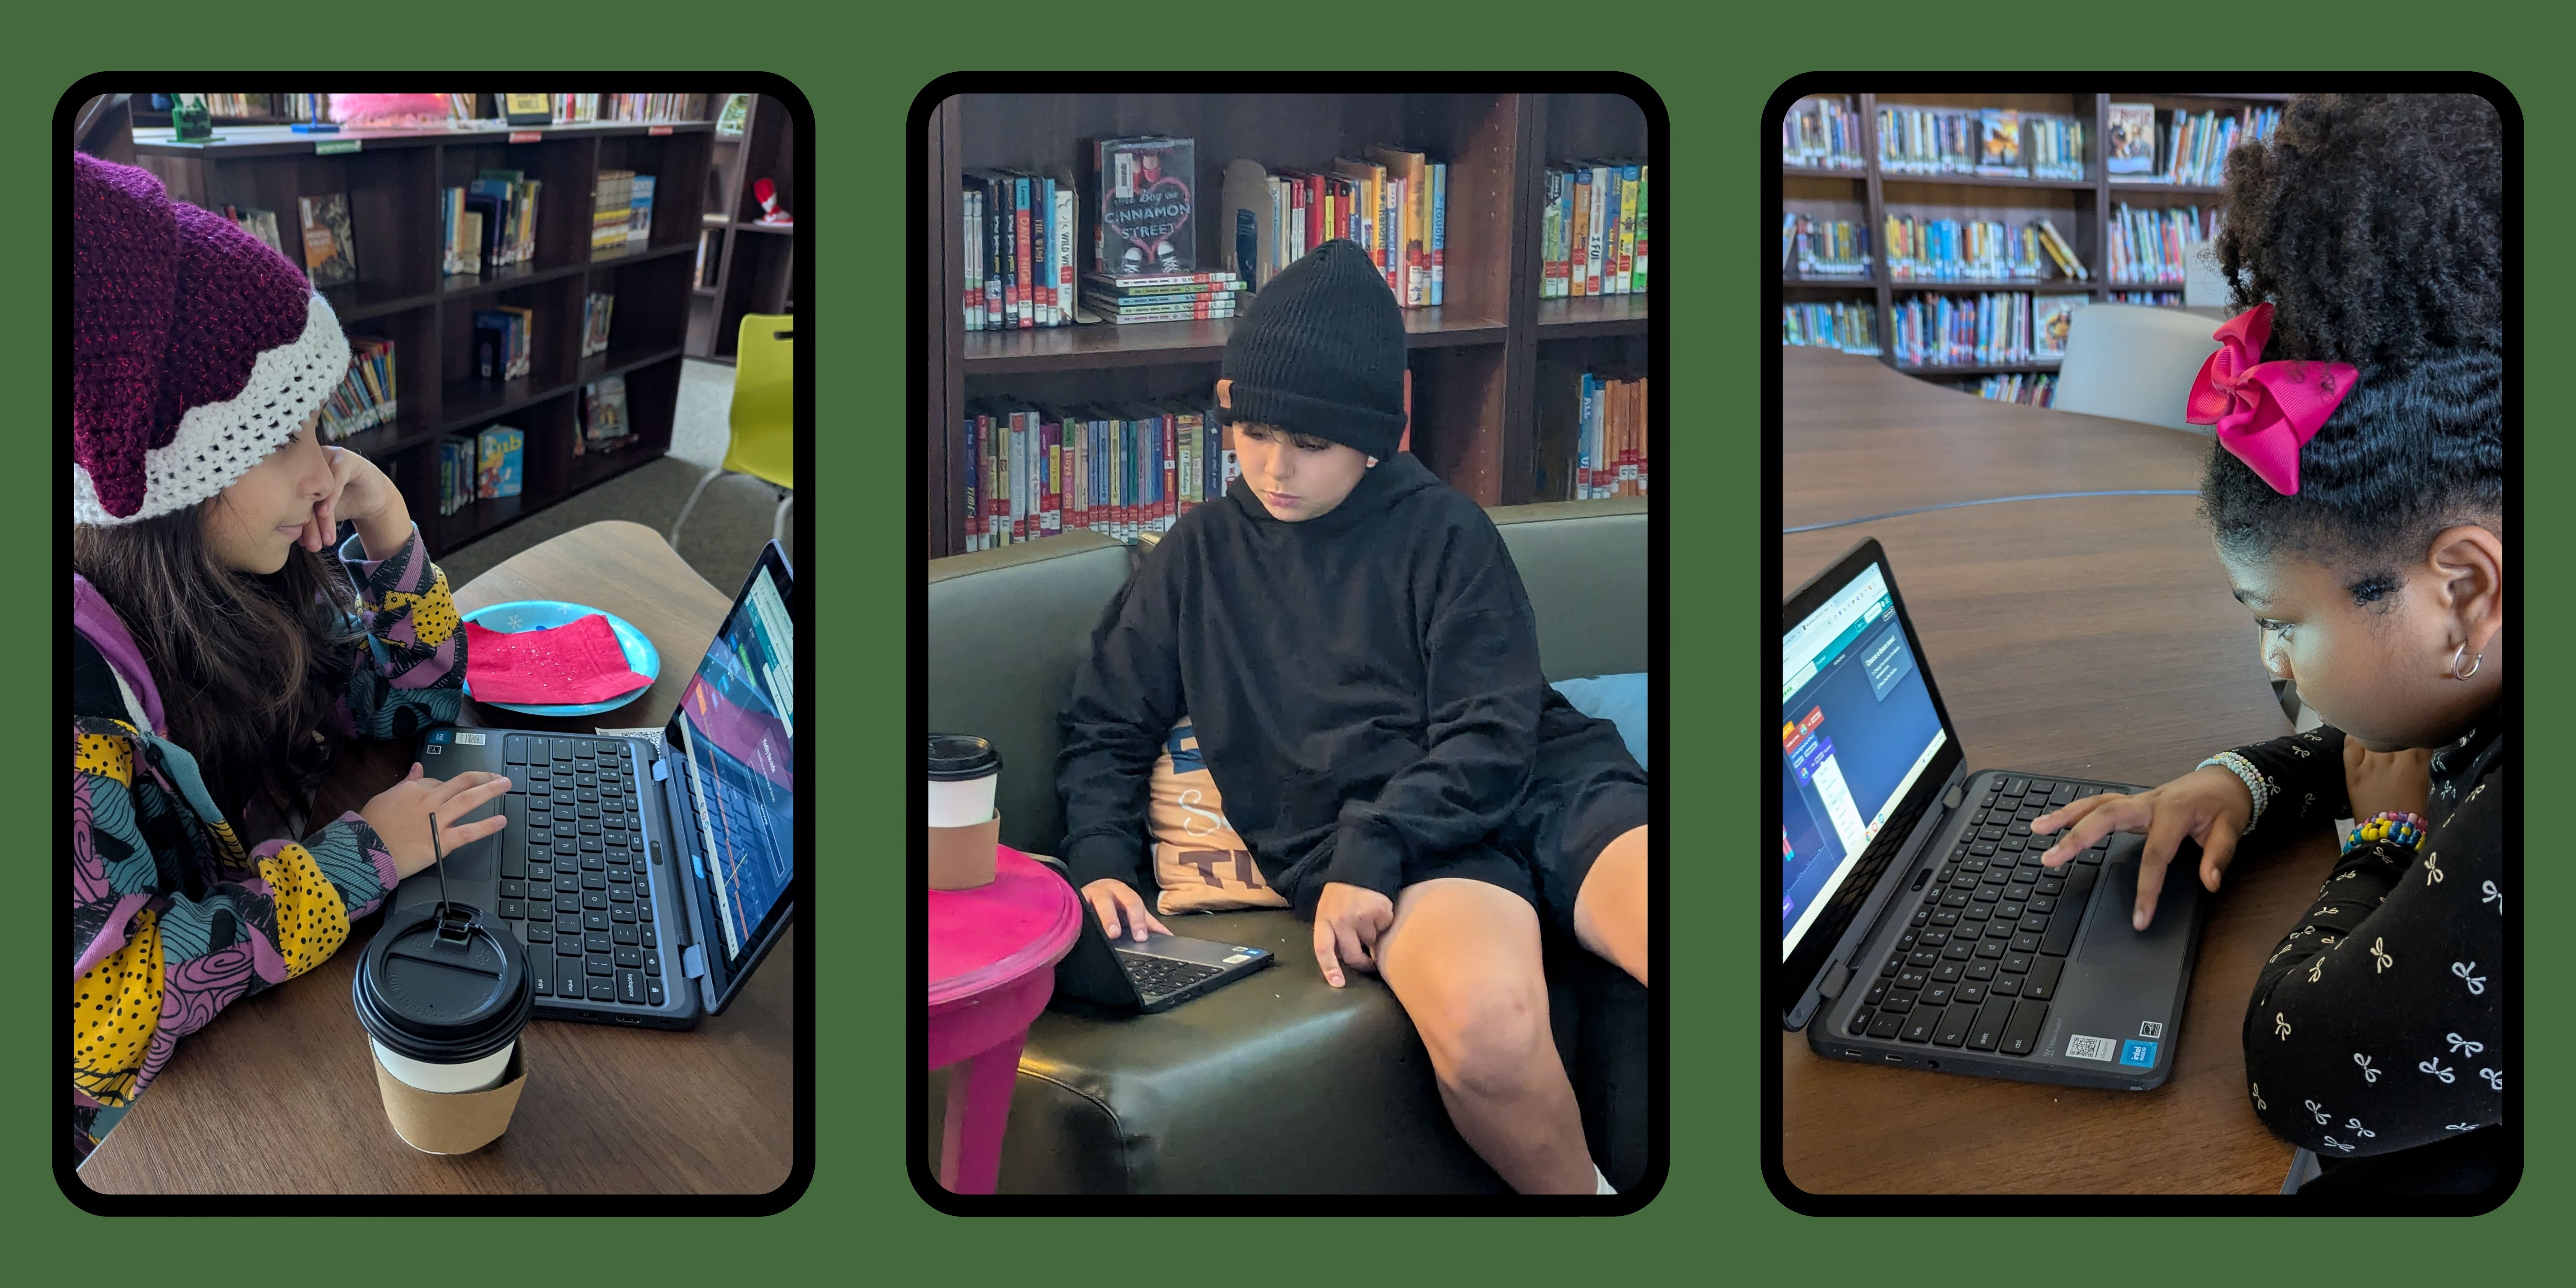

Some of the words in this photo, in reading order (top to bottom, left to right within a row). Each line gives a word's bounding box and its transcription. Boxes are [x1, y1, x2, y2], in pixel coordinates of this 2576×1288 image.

[1104, 203, 1191, 224] CINNAMON
[1121, 223, 1174, 240] STREET
[1914, 1027, 1922, 1035] tab
[1980, 1033, 1989, 1044] shift
[2131, 1046, 2142, 1061] intel
